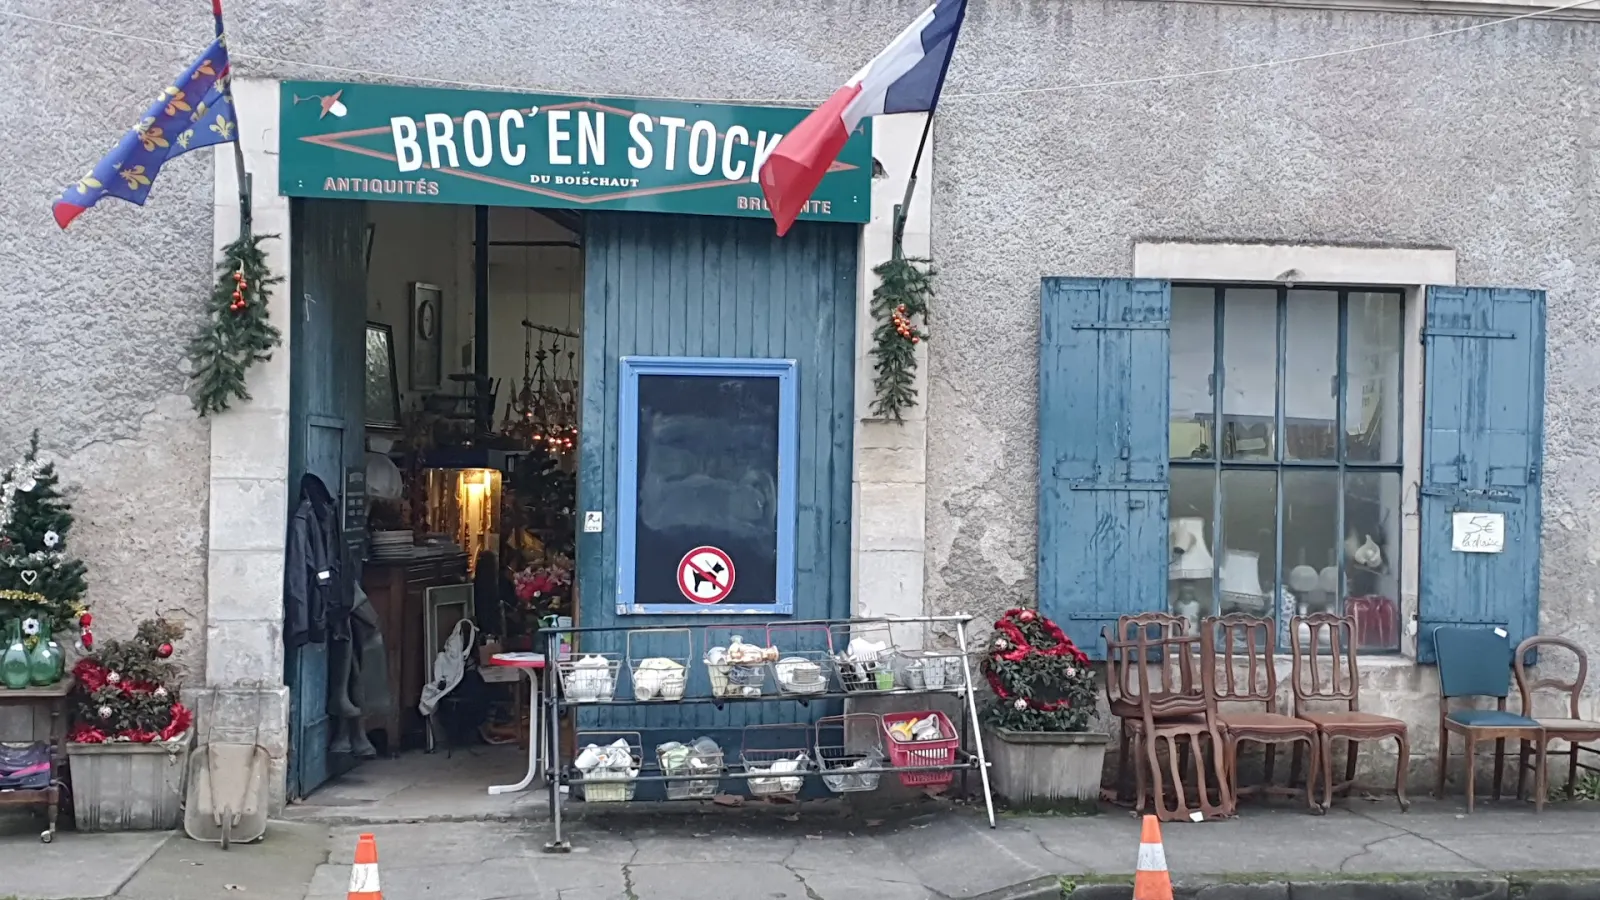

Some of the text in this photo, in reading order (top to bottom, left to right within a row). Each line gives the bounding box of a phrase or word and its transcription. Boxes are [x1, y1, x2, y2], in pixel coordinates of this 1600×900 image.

[628, 112, 783, 184] STOCK
[323, 177, 439, 195] ANTIQUITÉS
[530, 174, 551, 184] DU
[737, 196, 831, 215] BRNTE
